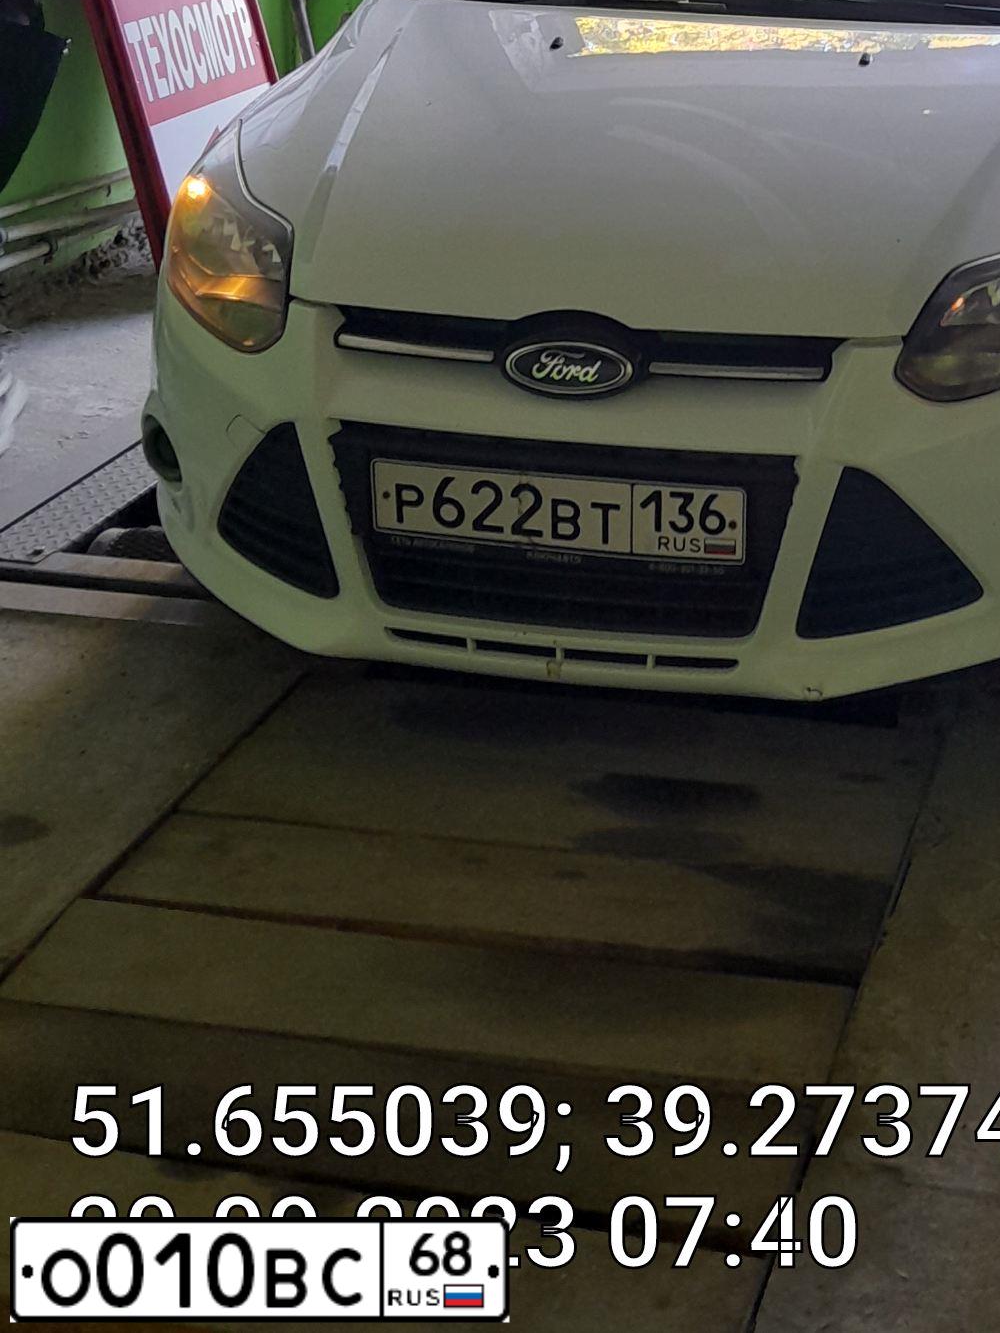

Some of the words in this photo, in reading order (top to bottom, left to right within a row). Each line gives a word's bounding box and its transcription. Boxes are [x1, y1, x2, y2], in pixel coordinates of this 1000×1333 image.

[532, 349, 602, 383] Ford
[394, 476, 621, 545] Р622ВТ
[639, 490, 727, 535] 136
[657, 536, 701, 554] RUS
